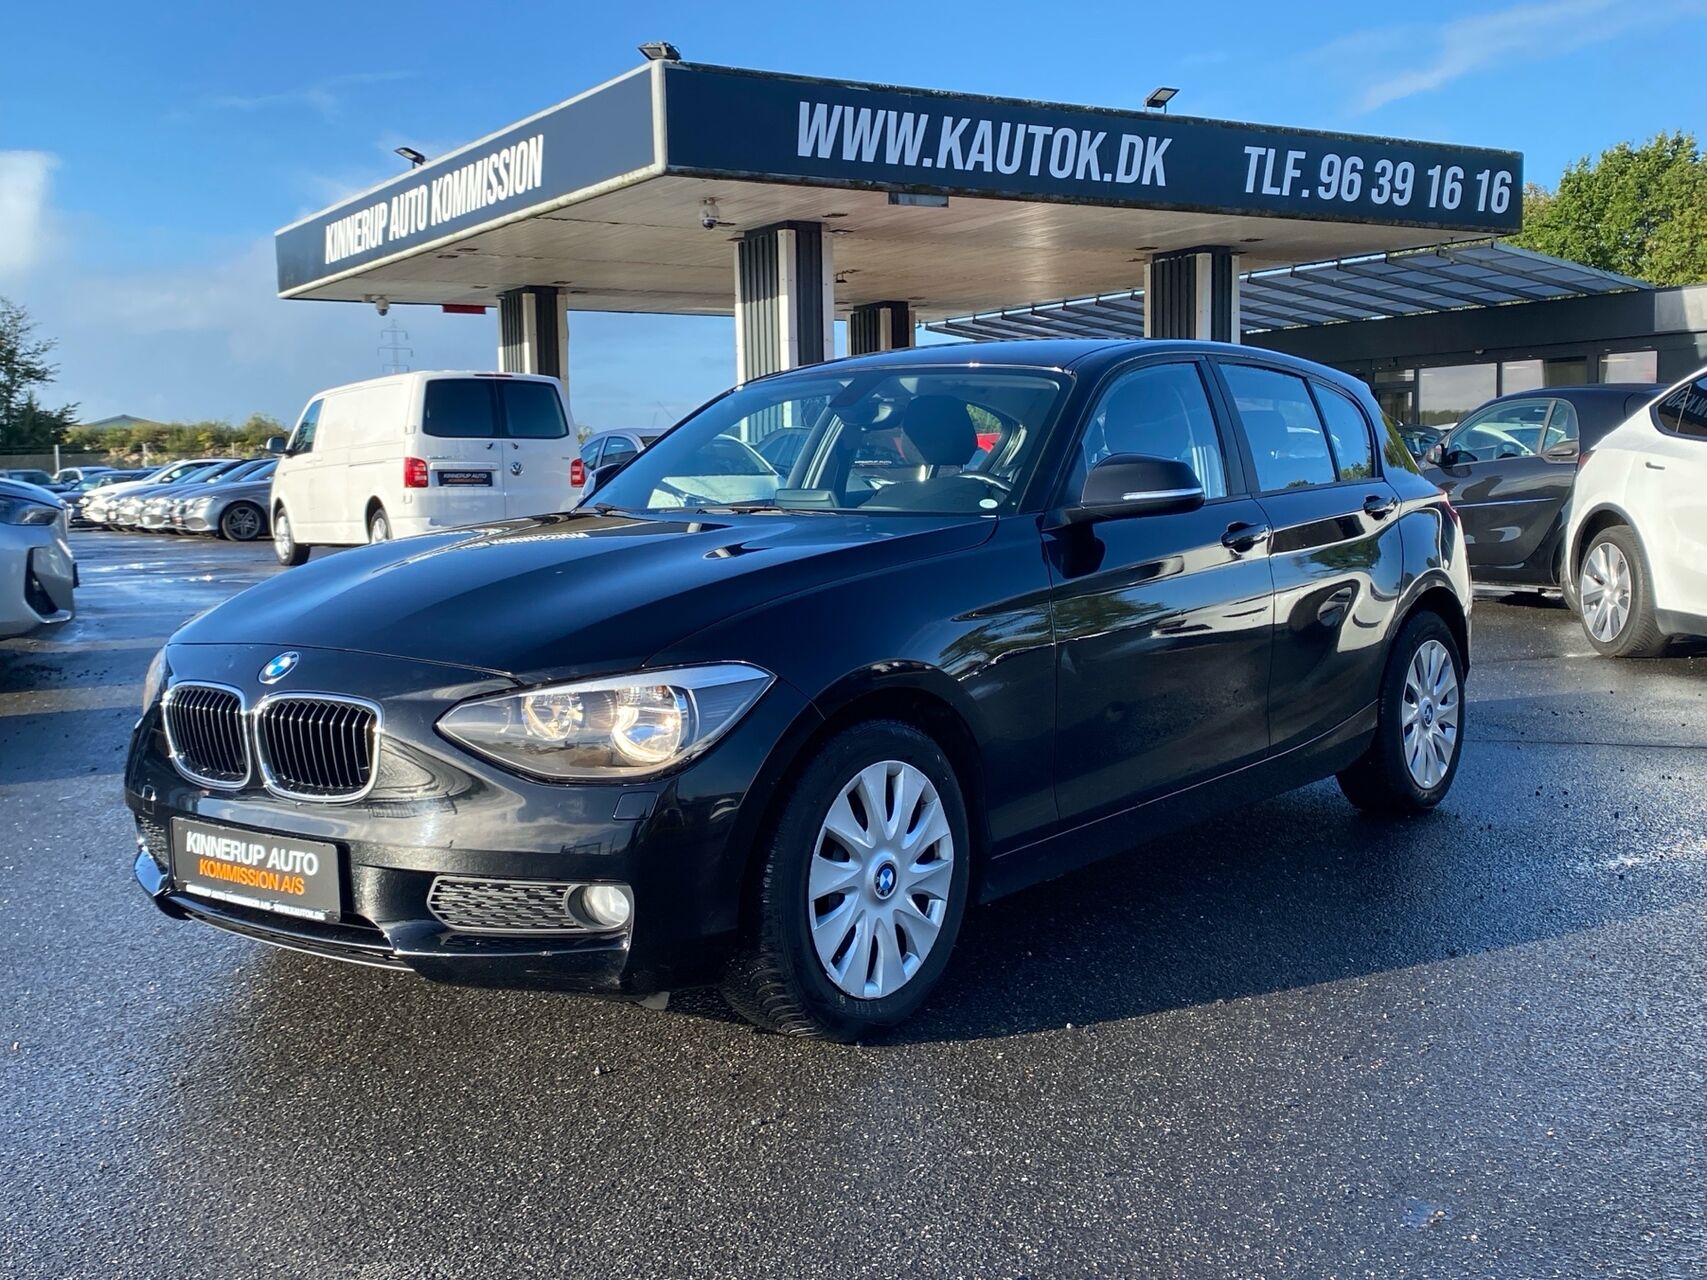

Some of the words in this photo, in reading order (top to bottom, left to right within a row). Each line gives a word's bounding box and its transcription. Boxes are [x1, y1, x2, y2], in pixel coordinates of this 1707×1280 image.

[797, 101, 1173, 188] WWW.KAUTOK.DK
[324, 201, 389, 265] KINNERUP
[388, 184, 429, 242] AUTO
[430, 133, 544, 227] KOMMISSION
[1244, 145, 1310, 198] TLF.
[1317, 153, 1364, 202] 96
[1370, 159, 1415, 206] 39
[1427, 164, 1465, 210] 16
[1476, 169, 1512, 214] 16
[186, 831, 266, 866] KINNERUP
[266, 847, 319, 876] AUTO
[199, 858, 279, 891] KOMMISSION
[280, 876, 305, 896] A/S
